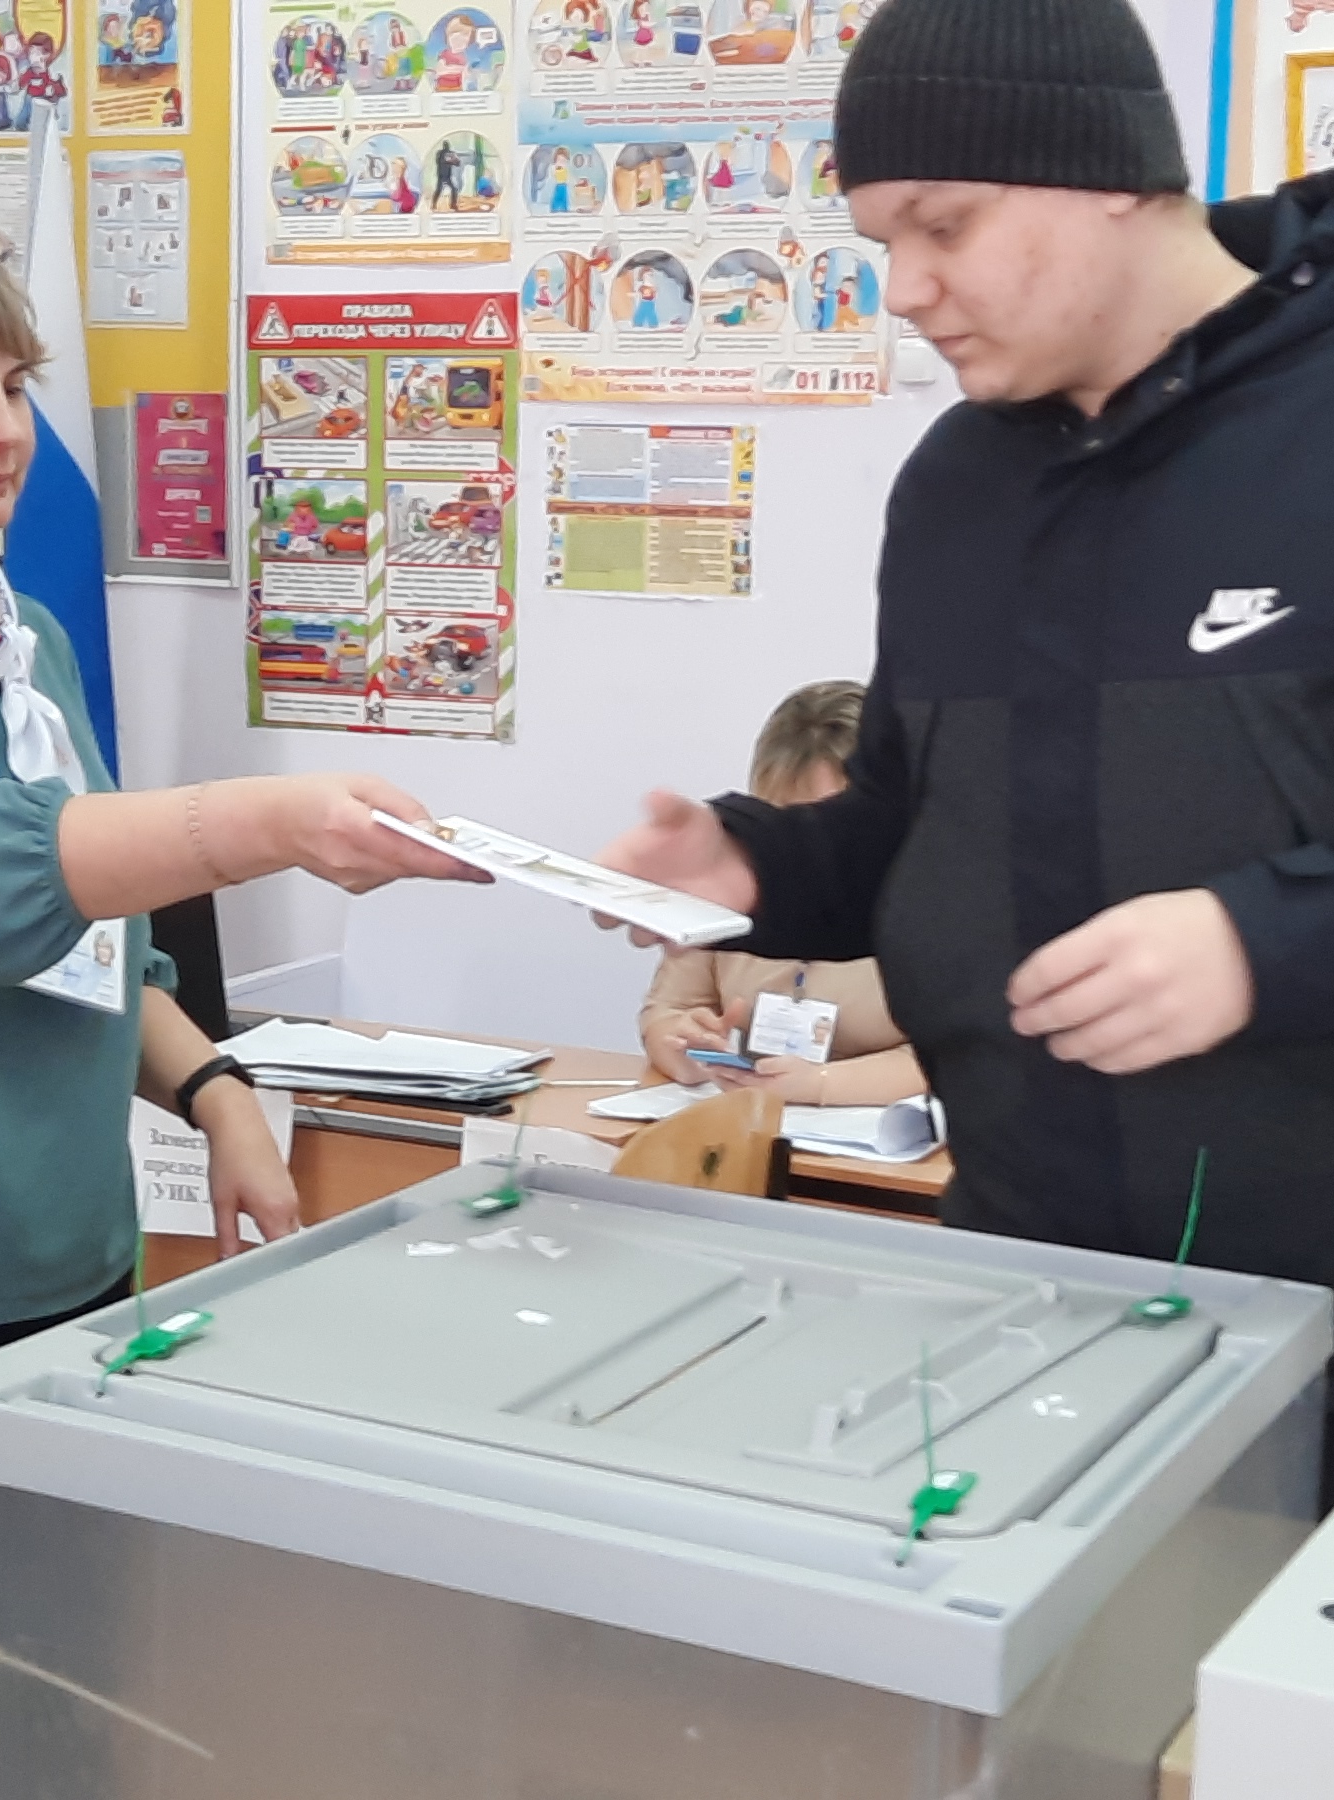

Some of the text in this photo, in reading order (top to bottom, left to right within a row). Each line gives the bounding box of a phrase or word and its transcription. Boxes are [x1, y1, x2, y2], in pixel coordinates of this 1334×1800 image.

[342, 304, 413, 318] ПРАВИЛА
[292, 324, 467, 339] ПЕРЕХОДА ЧЕРЕЗ УЛИЦУ
[796, 371, 820, 390] 01
[842, 371, 876, 391] 112
[153, 1182, 200, 1202] УИК
